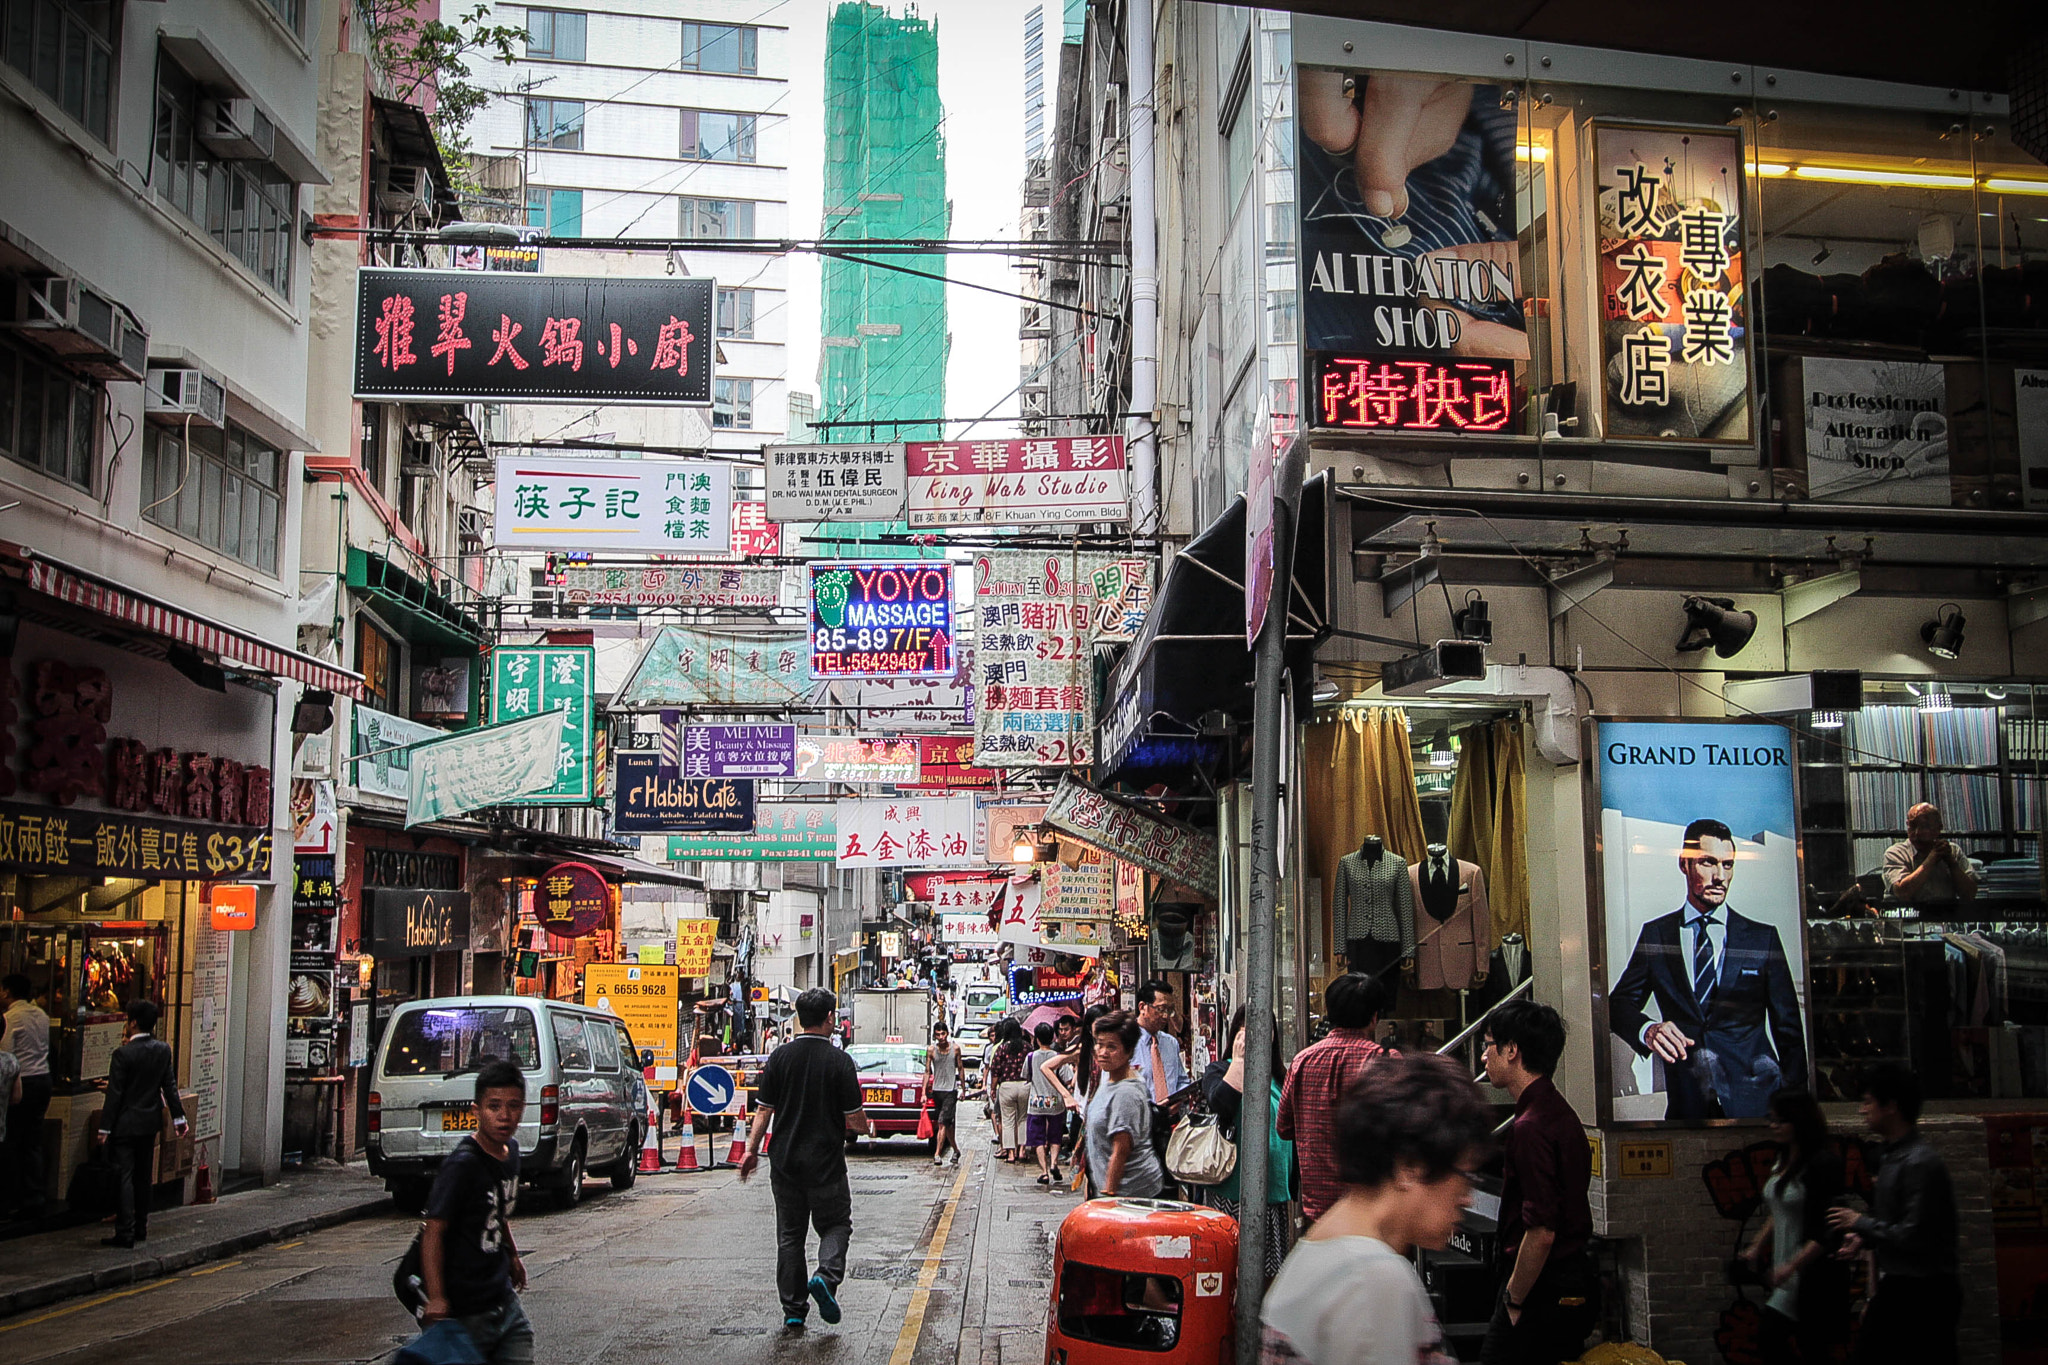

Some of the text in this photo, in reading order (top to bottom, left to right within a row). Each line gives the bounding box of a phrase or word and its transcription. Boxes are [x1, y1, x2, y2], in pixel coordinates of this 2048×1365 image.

[1309, 251, 1515, 304] ALTERATION
[1616, 163, 1671, 405] 改衣店
[1679, 206, 1735, 366] 專業
[1374, 305, 1462, 349] SHOP
[1812, 391, 1939, 412] Professional
[1824, 422, 1931, 442] Alteration
[921, 439, 1110, 473] 京華攝影
[1853, 453, 1905, 470] Shop
[815, 489, 832, 497] MAN
[833, 489, 860, 497] DENTAL
[862, 488, 898, 496] SURGEON
[926, 478, 973, 505] King
[1038, 473, 1108, 495] Studio
[513, 484, 641, 520] 筷子記
[985, 512, 1001, 520] 8/F
[1005, 511, 1036, 520] Khuan
[1040, 510, 1060, 521] Ying
[1064, 509, 1097, 519] Comm.
[1101, 508, 1122, 518] Bldg
[855, 570, 945, 602] YOYO
[1027, 576, 1041, 595] 至
[848, 603, 944, 626] MASSAGE
[816, 628, 931, 651] 85-89 7/F
[981, 633, 1084, 660] 送熱飲 $22
[983, 660, 1027, 686] 澳門
[723, 727, 782, 739] MEI MEI
[686, 727, 711, 777] 美美
[715, 740, 791, 750] Beauty & Massage
[981, 735, 1086, 763] 送熱飲 $26
[1607, 742, 1789, 767] GRAND TAILOR
[628, 758, 653, 766] Lunch
[645, 775, 738, 811] Habibi Café
[781, 832, 803, 842] and
[840, 829, 967, 860] 五金漆油
[727, 849, 753, 857] 7047
[1880, 907, 1920, 918] Grand Tailor
[406, 905, 437, 947] Habibi
[614, 984, 666, 995] 6655 9628
[443, 1120, 478, 1131] 5322
[452, 1110, 467, 1120] NT
